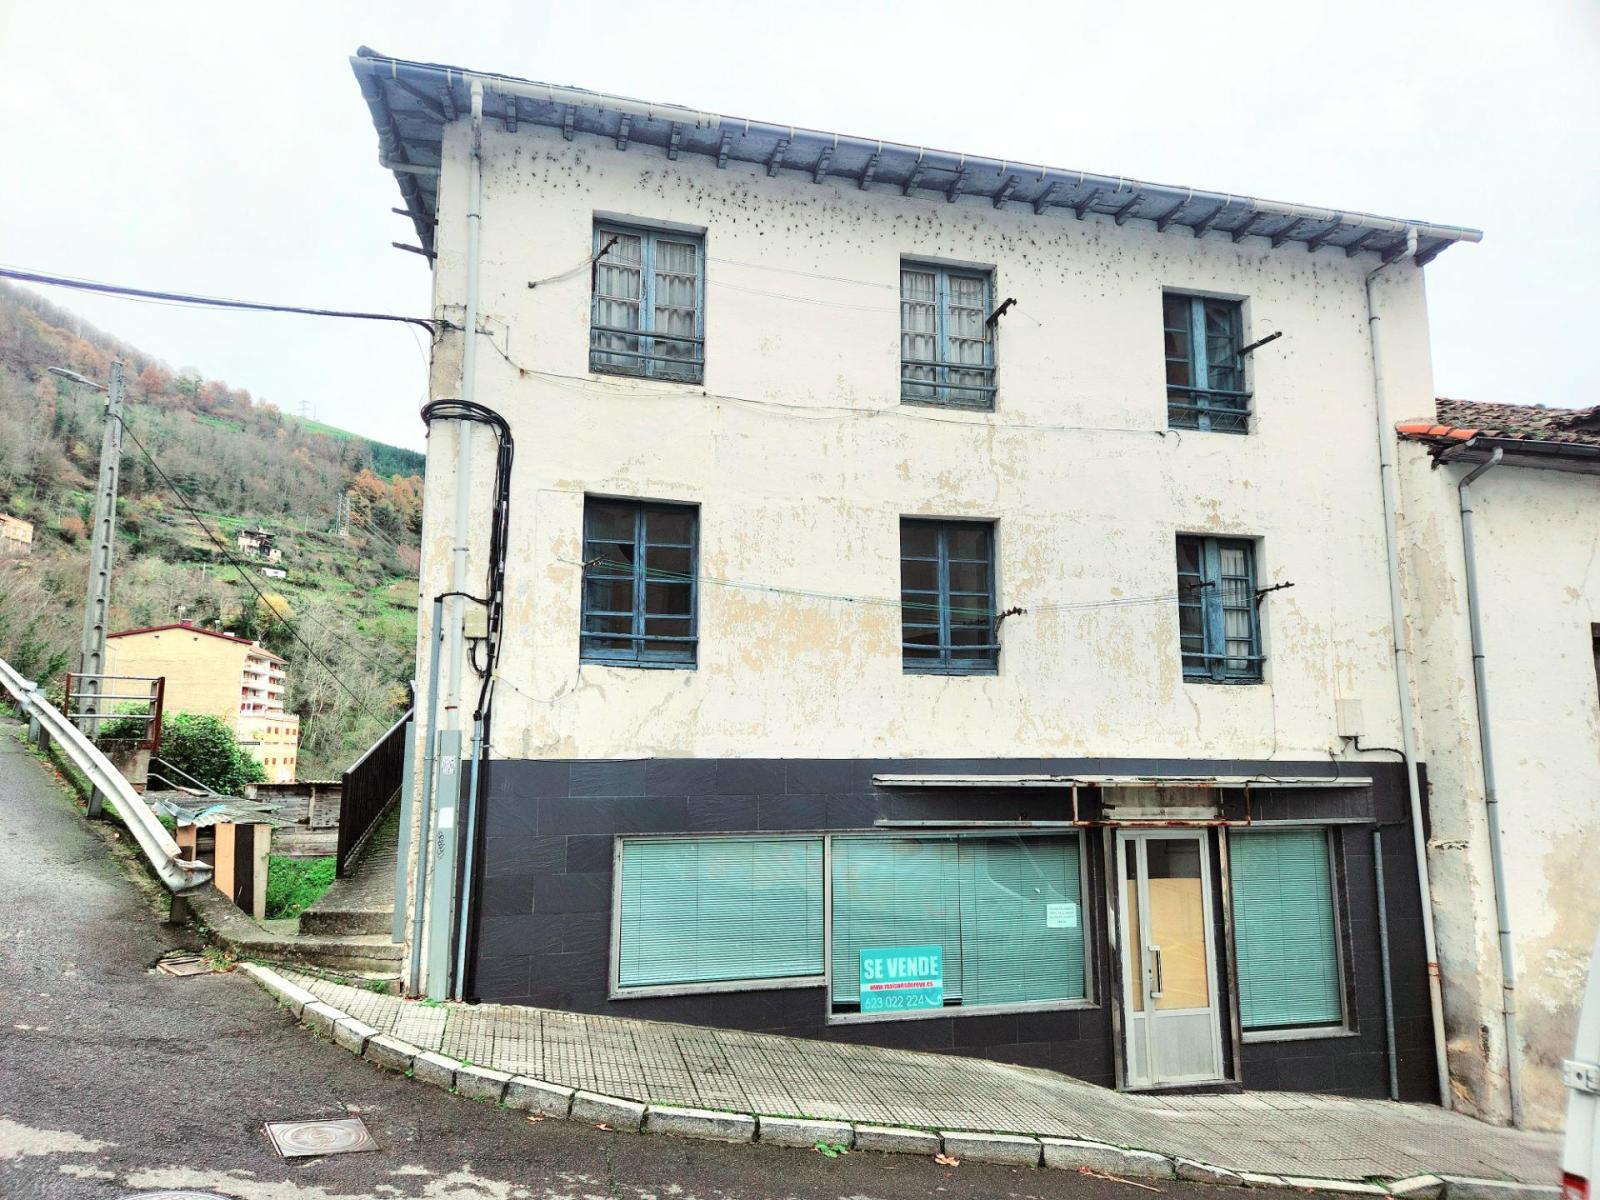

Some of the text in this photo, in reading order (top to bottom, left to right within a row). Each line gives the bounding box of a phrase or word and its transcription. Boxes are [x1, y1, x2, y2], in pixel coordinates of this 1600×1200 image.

[864, 955, 939, 980] SE VENDE
[865, 994, 924, 1009] 623 022 224
